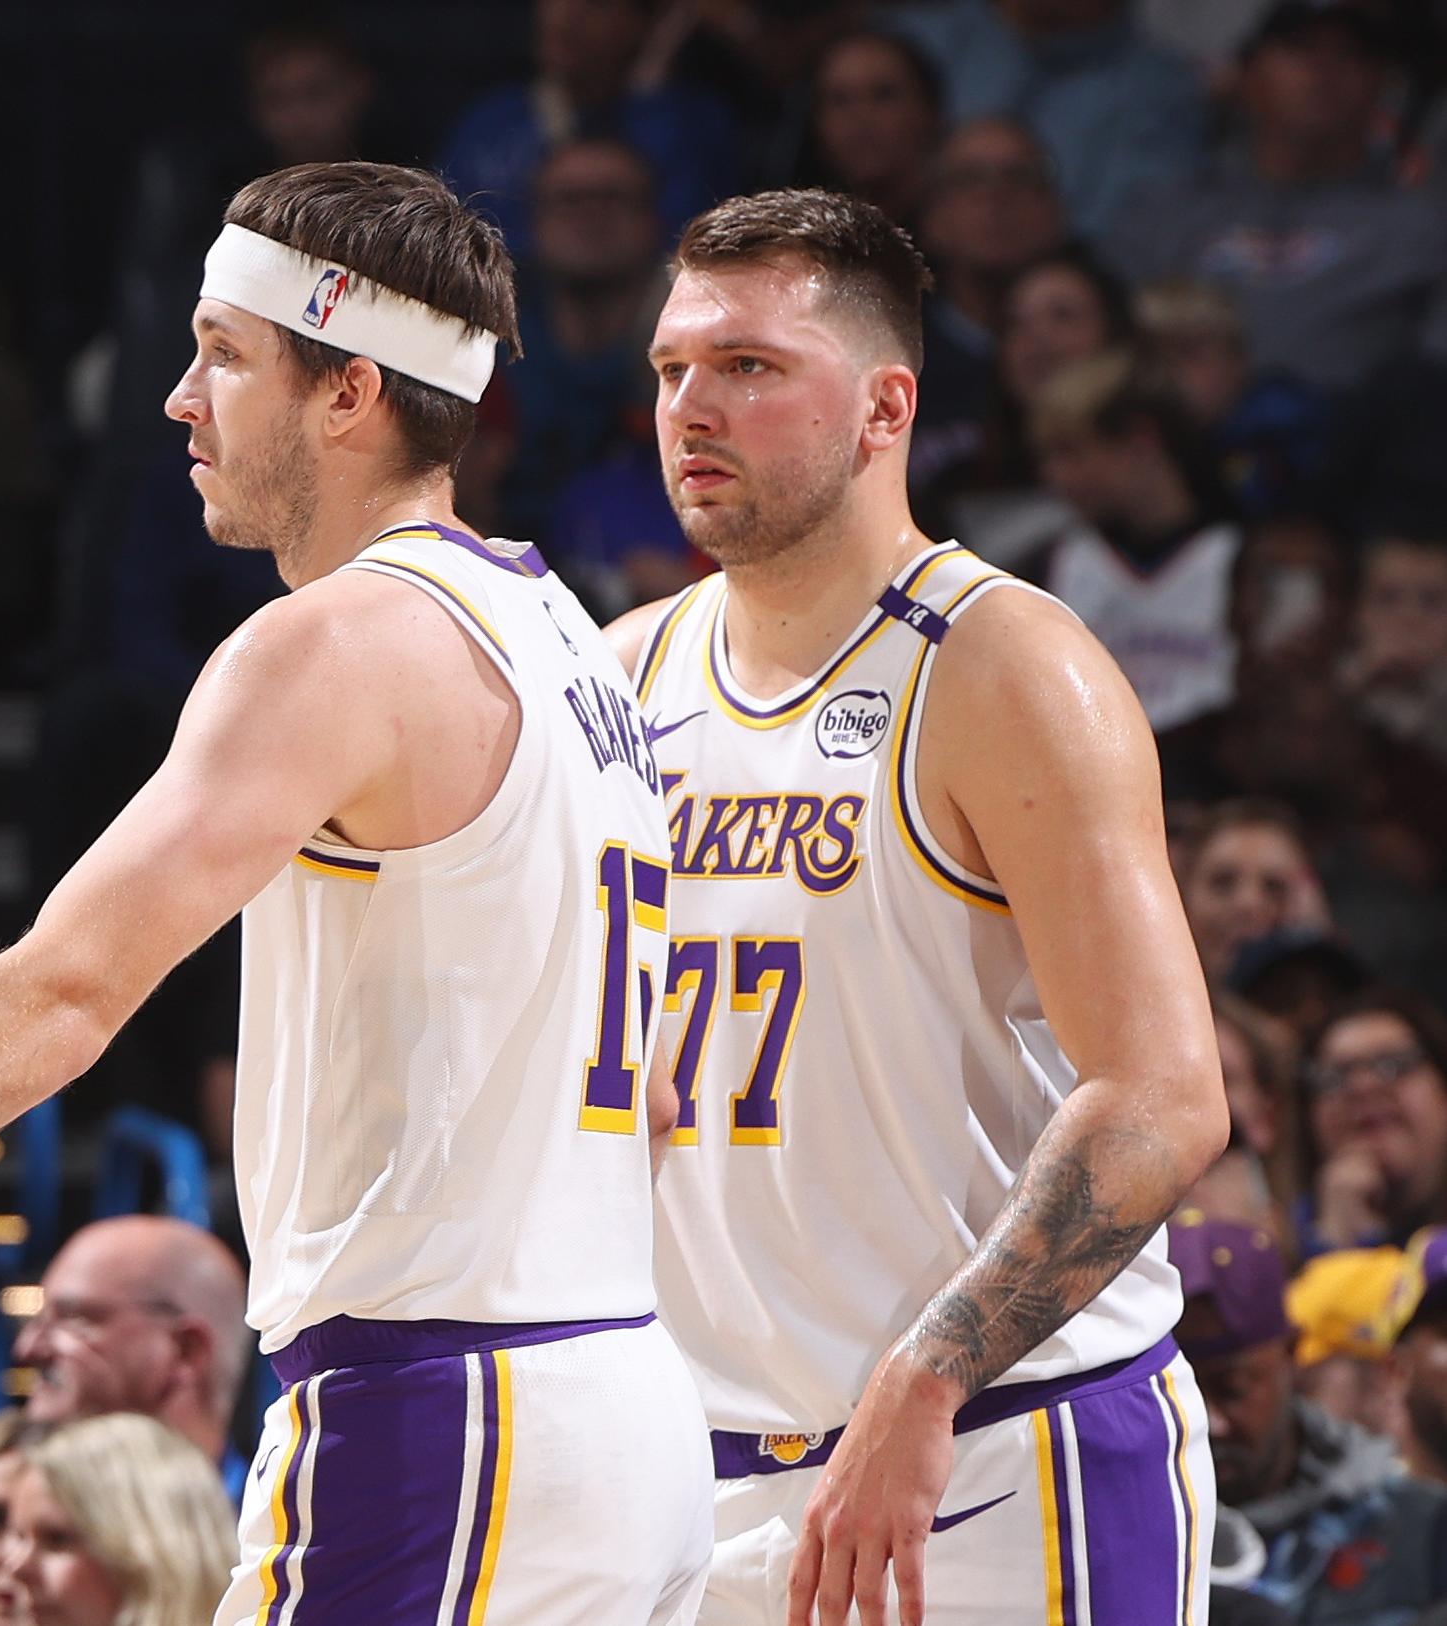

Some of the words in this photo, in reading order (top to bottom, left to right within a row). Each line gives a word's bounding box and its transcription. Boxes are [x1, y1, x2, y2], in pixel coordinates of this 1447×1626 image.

[904, 604, 930, 628] 14
[823, 708, 888, 739] bibigo
[662, 933, 808, 1147] 77
